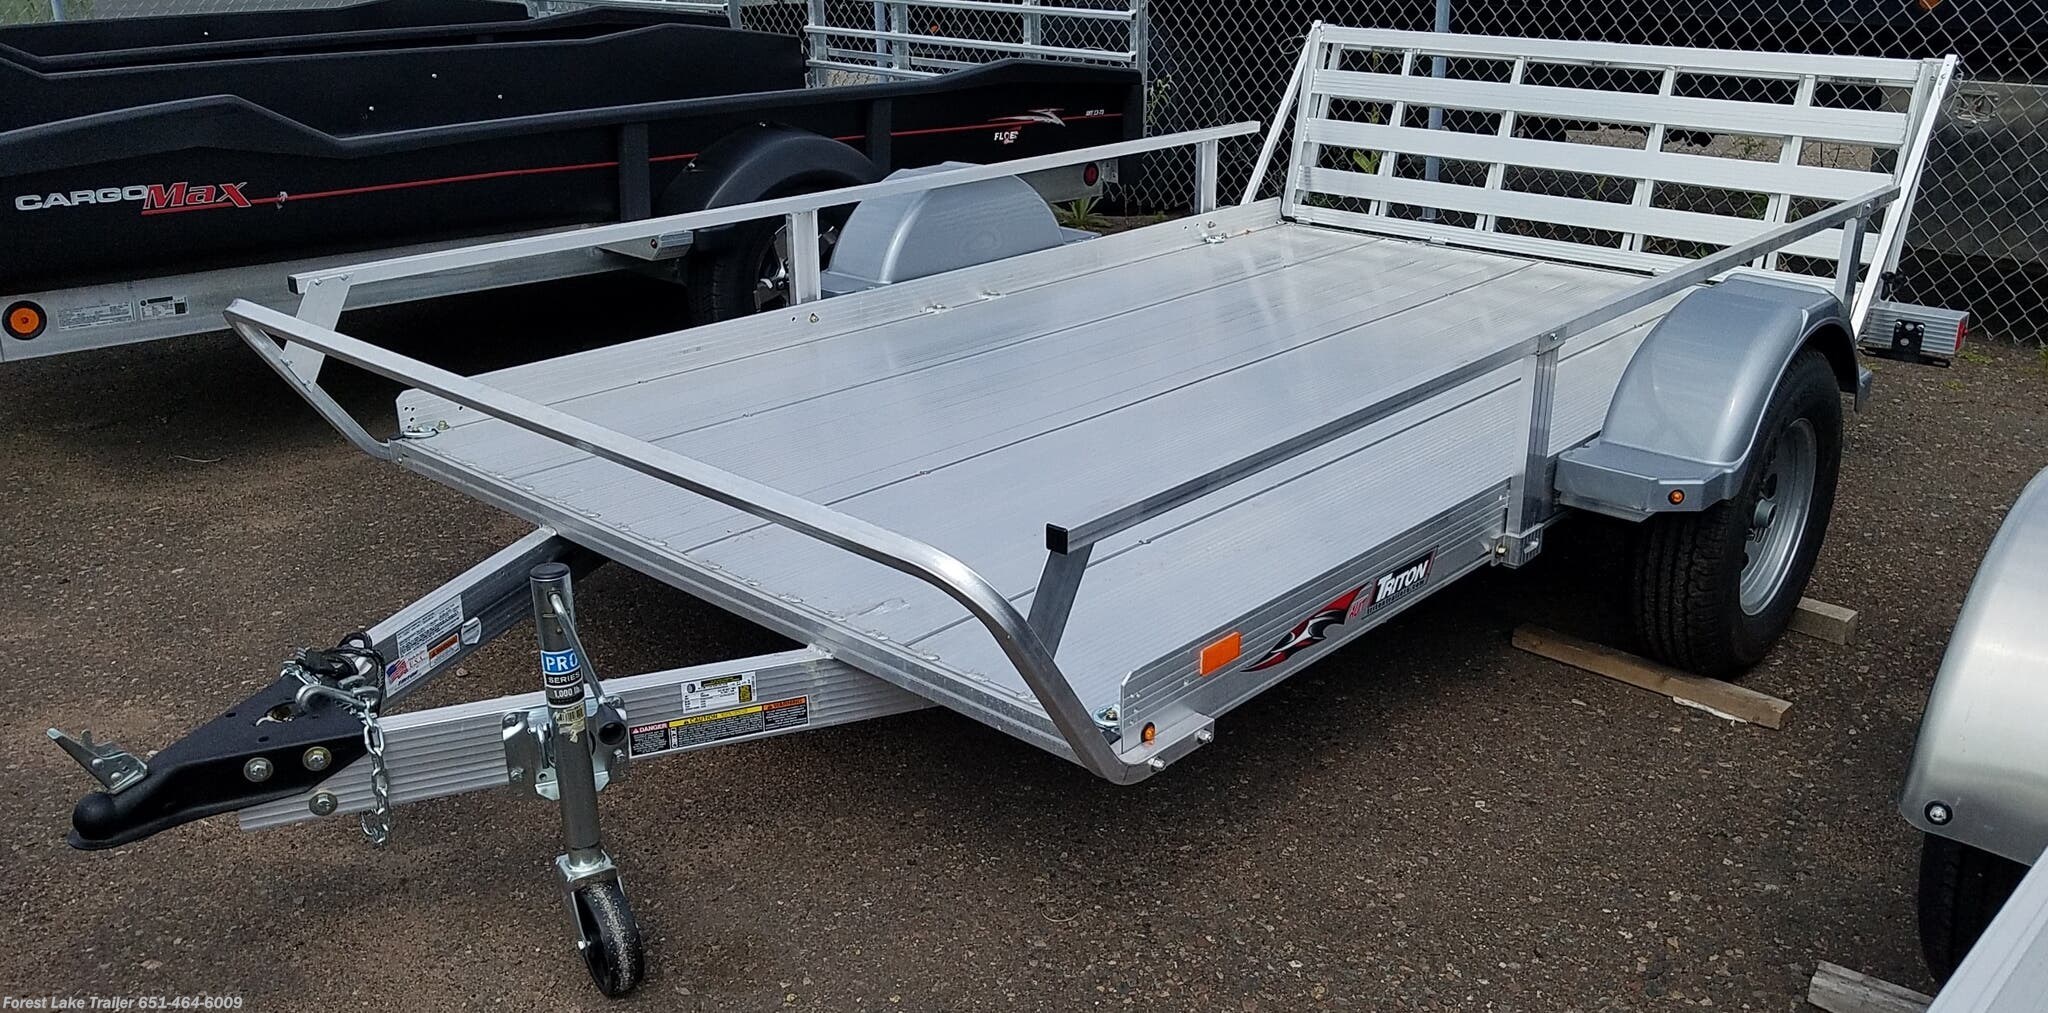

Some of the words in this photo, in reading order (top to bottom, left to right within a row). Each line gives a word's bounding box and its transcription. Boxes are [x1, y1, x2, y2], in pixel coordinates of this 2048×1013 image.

[1376, 559, 1430, 602] TRITON
[545, 653, 578, 671] PRO
[548, 671, 580, 684] SERIES
[689, 714, 718, 724] CAUTION
[639, 723, 667, 733] DANGER
